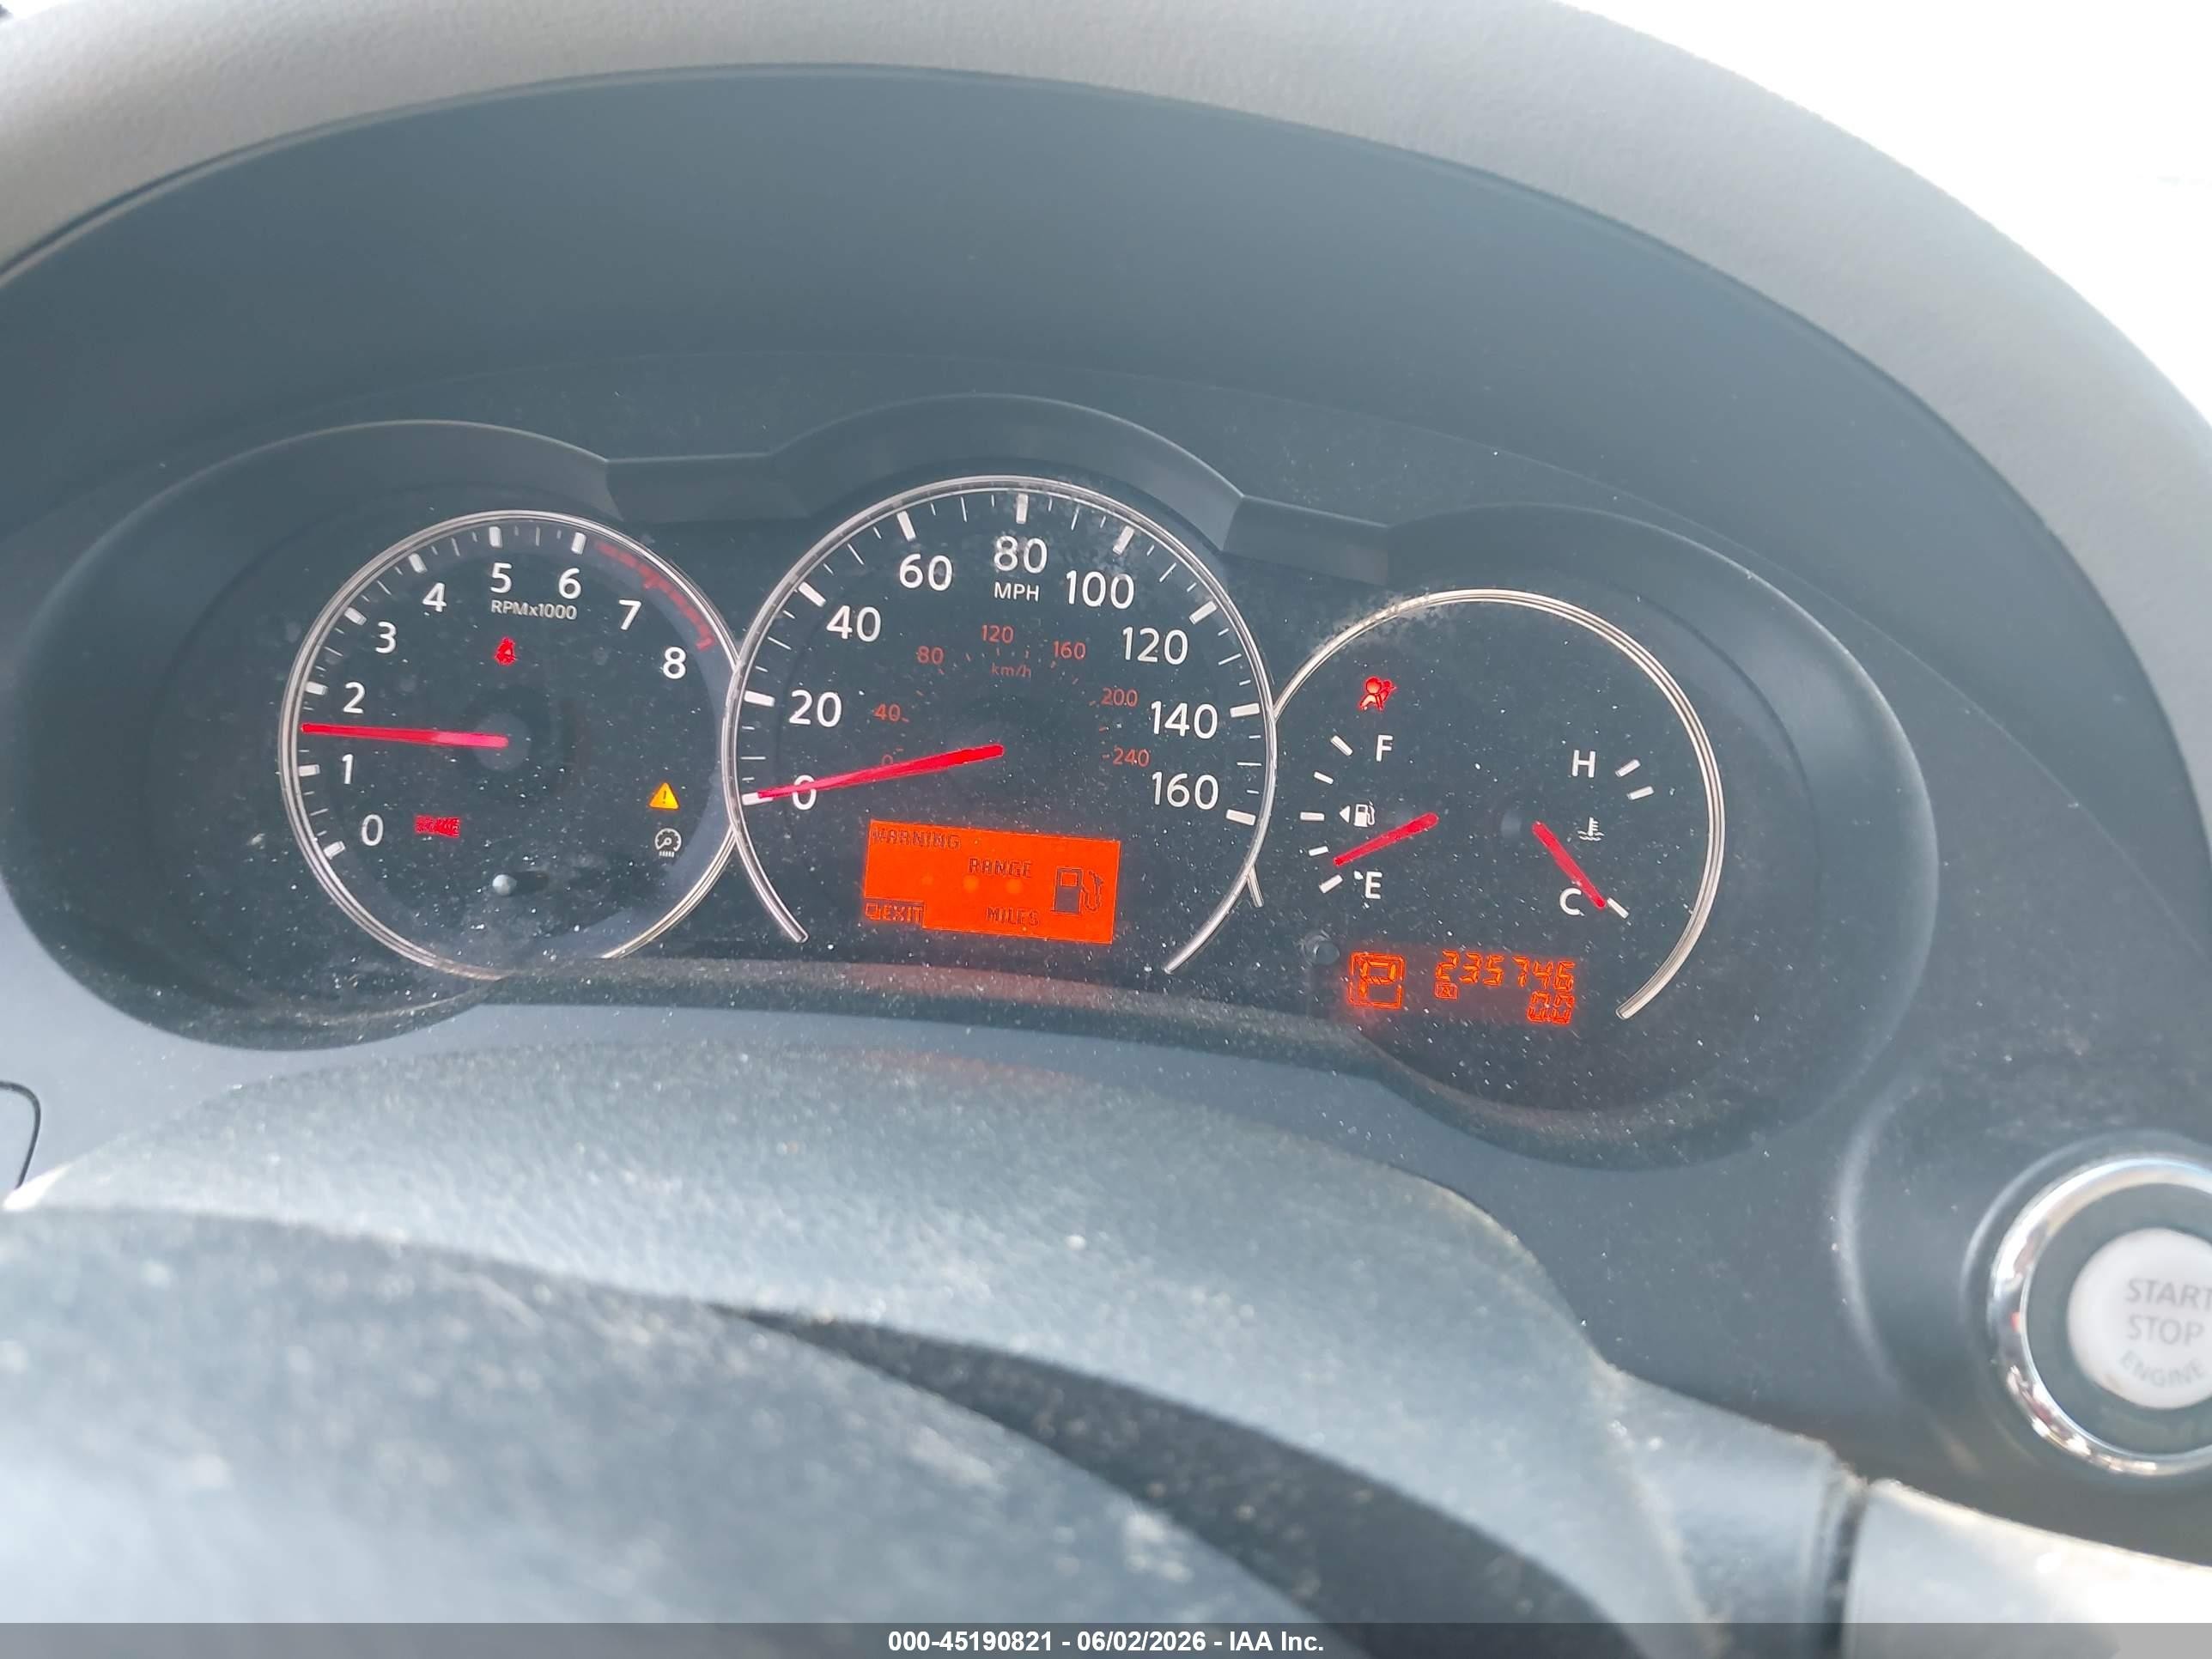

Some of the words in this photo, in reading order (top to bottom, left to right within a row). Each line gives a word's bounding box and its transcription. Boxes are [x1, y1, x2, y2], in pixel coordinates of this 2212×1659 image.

[993, 536, 1048, 574] 80
[490, 562, 513, 593] 5
[558, 568, 582, 599] 6
[898, 554, 953, 592] 60
[422, 582, 447, 613] 4
[993, 582, 1040, 603] MPH
[1065, 570, 1135, 610] 100
[490, 600, 577, 621] RPMx1000
[618, 599, 641, 630] 7
[826, 606, 882, 643] 40
[375, 621, 398, 653] 3
[981, 624, 1014, 644] 120
[1052, 640, 1086, 659] 160
[1122, 627, 1189, 665] 120
[662, 647, 686, 679] 8
[916, 646, 944, 665] 80
[991, 662, 1031, 678] km/h
[343, 682, 365, 714] 2
[788, 690, 842, 728] 20
[873, 702, 901, 722] 40
[1101, 687, 1138, 707] 200
[1151, 701, 1218, 739] 140
[1113, 746, 1150, 767] 240
[1376, 734, 1394, 762] F
[1572, 750, 1596, 777] H
[342, 754, 354, 785] 1
[792, 774, 817, 811] 0
[1152, 772, 1219, 810] 160
[361, 812, 385, 847] 0
[871, 829, 961, 850] WARNING
[969, 858, 1032, 878] RANGE
[1365, 871, 1382, 899] E
[883, 905, 923, 922] EXIT
[988, 907, 1040, 927] MILES
[1559, 888, 1583, 915] C
[1435, 950, 1575, 990] 235746
[2125, 1278, 2212, 1311] START
[2127, 1315, 2205, 1346] STOP
[2119, 1349, 2207, 1389] ENGINE
